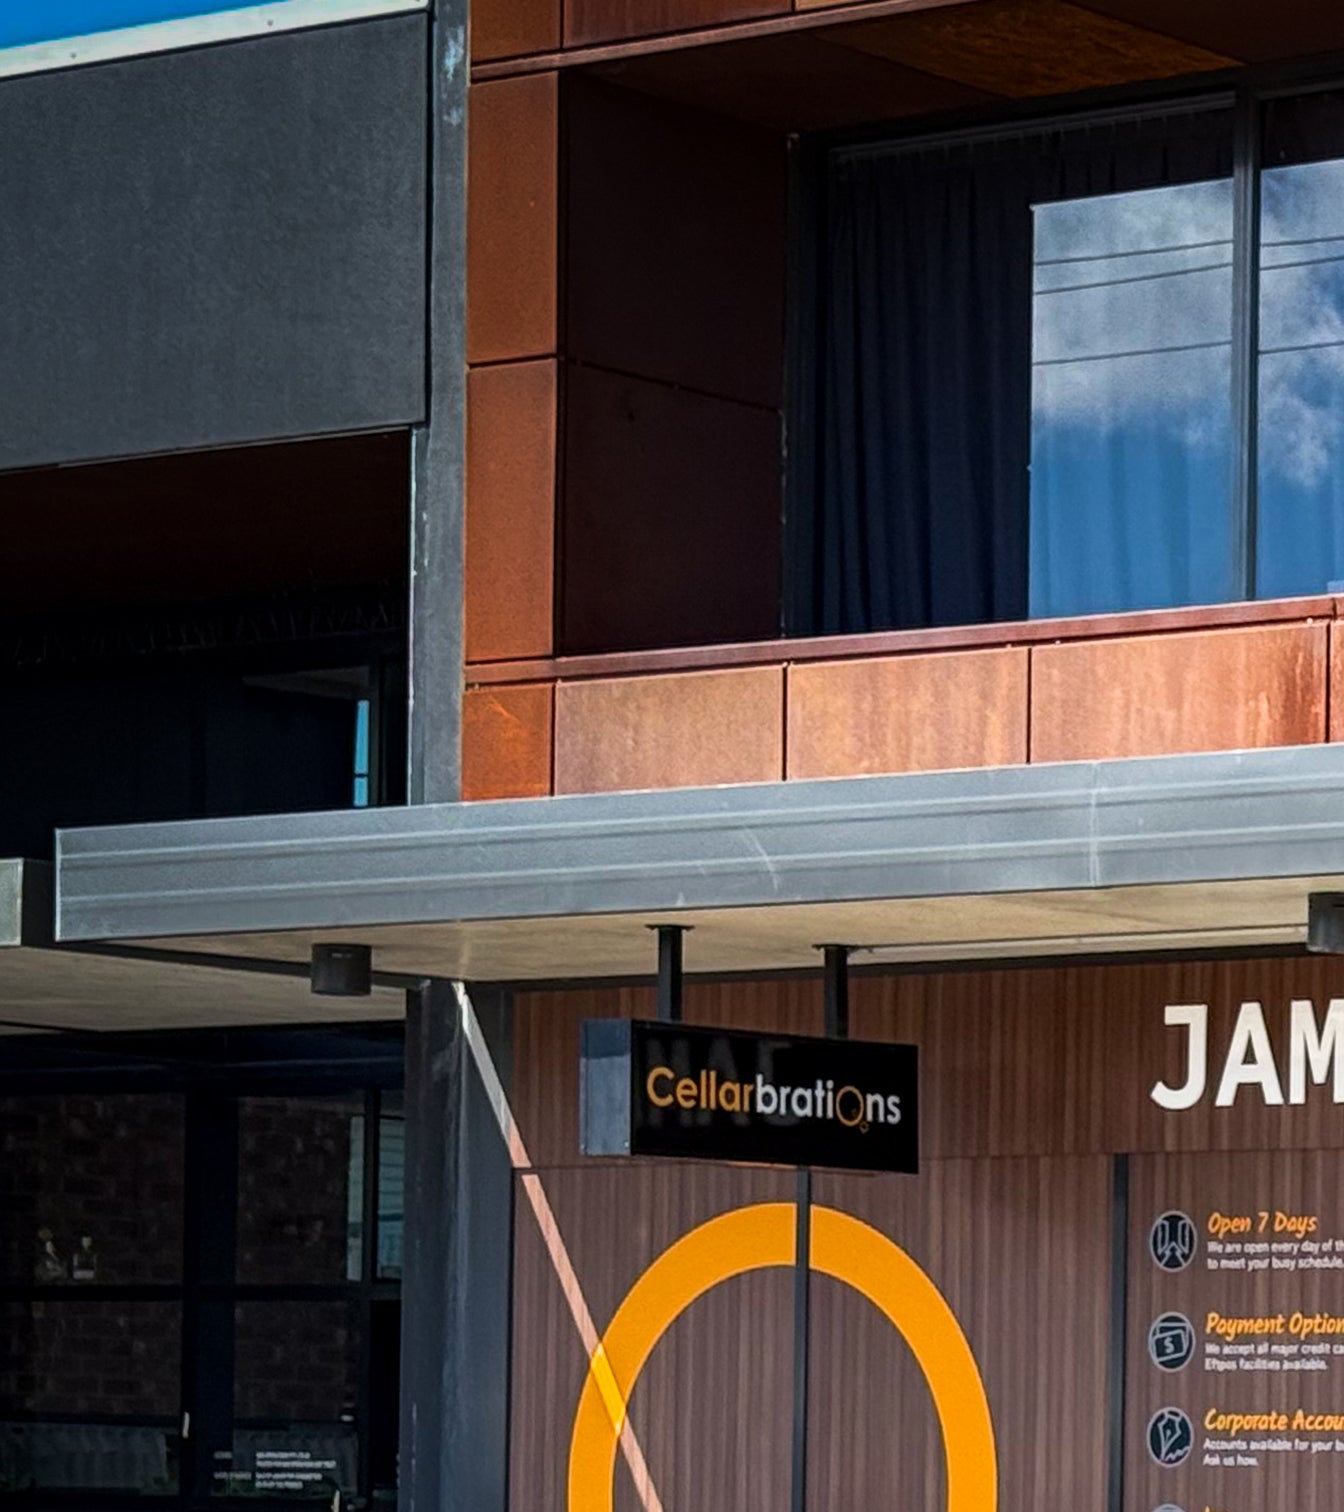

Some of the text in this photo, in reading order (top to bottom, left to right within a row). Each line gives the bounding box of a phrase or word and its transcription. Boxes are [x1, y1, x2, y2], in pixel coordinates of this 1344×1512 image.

[647, 1067, 901, 1133] Cellarbrations
[1207, 1213, 1318, 1239] Open 7 Days
[1224, 1243, 1241, 1253] are
[1244, 1243, 1269, 1255] open
[1272, 1242, 1298, 1255] every
[1302, 1241, 1319, 1255] day
[1322, 1240, 1333, 1252] of
[1208, 1258, 1217, 1269] to
[1221, 1259, 1245, 1269] meet
[1248, 1259, 1269, 1271] your
[1272, 1257, 1295, 1271] busy
[1206, 1313, 1285, 1341] Payment
[1222, 1344, 1255, 1356] accept
[1257, 1343, 1268, 1354] all
[1271, 1344, 1298, 1357] major
[1301, 1343, 1330, 1354] credit
[1240, 1358, 1280, 1370] facilities
[1205, 1409, 1286, 1435] Corporate
[1203, 1439, 1247, 1450] Accounts
[1250, 1439, 1292, 1450] available
[1295, 1439, 1309, 1450] for
[1312, 1441, 1333, 1453] your
[1203, 1455, 1220, 1466] Ask
[1223, 1457, 1234, 1466] us
